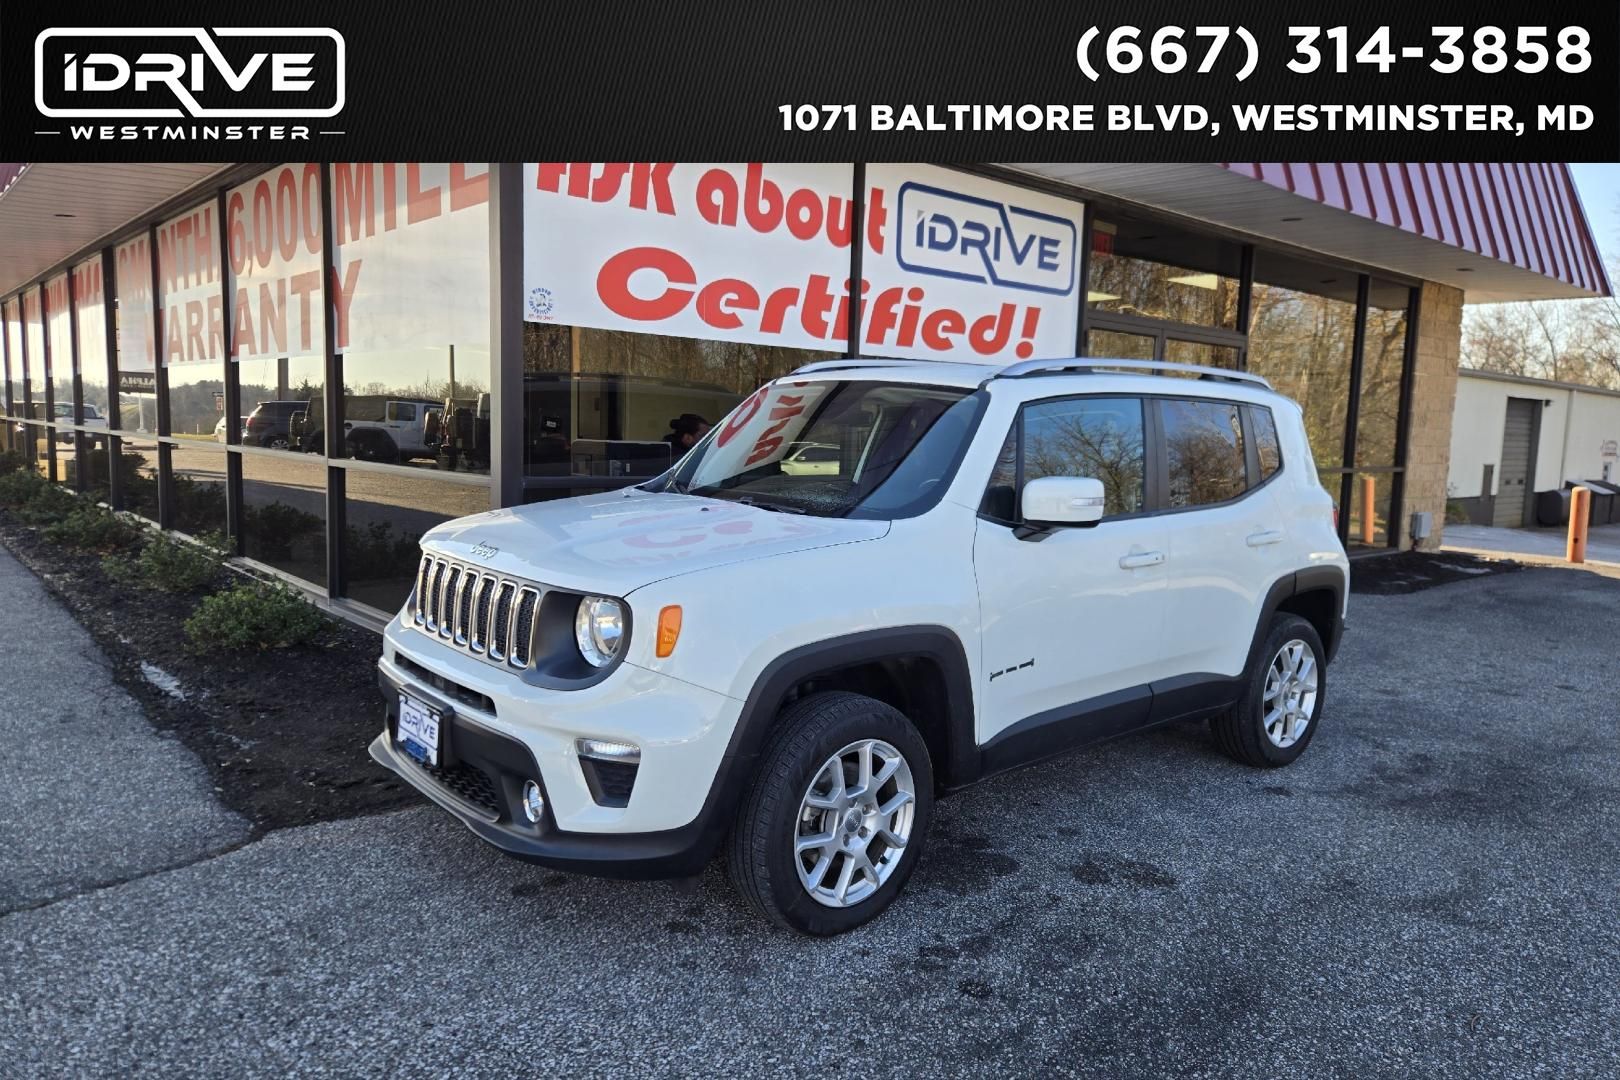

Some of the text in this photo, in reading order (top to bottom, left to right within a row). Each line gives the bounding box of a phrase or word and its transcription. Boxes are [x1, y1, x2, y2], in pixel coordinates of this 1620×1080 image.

[228, 164, 321, 277] 6,000
[695, 163, 887, 255] about
[144, 258, 362, 364] WARRANTY
[597, 246, 1041, 360] Certified!
